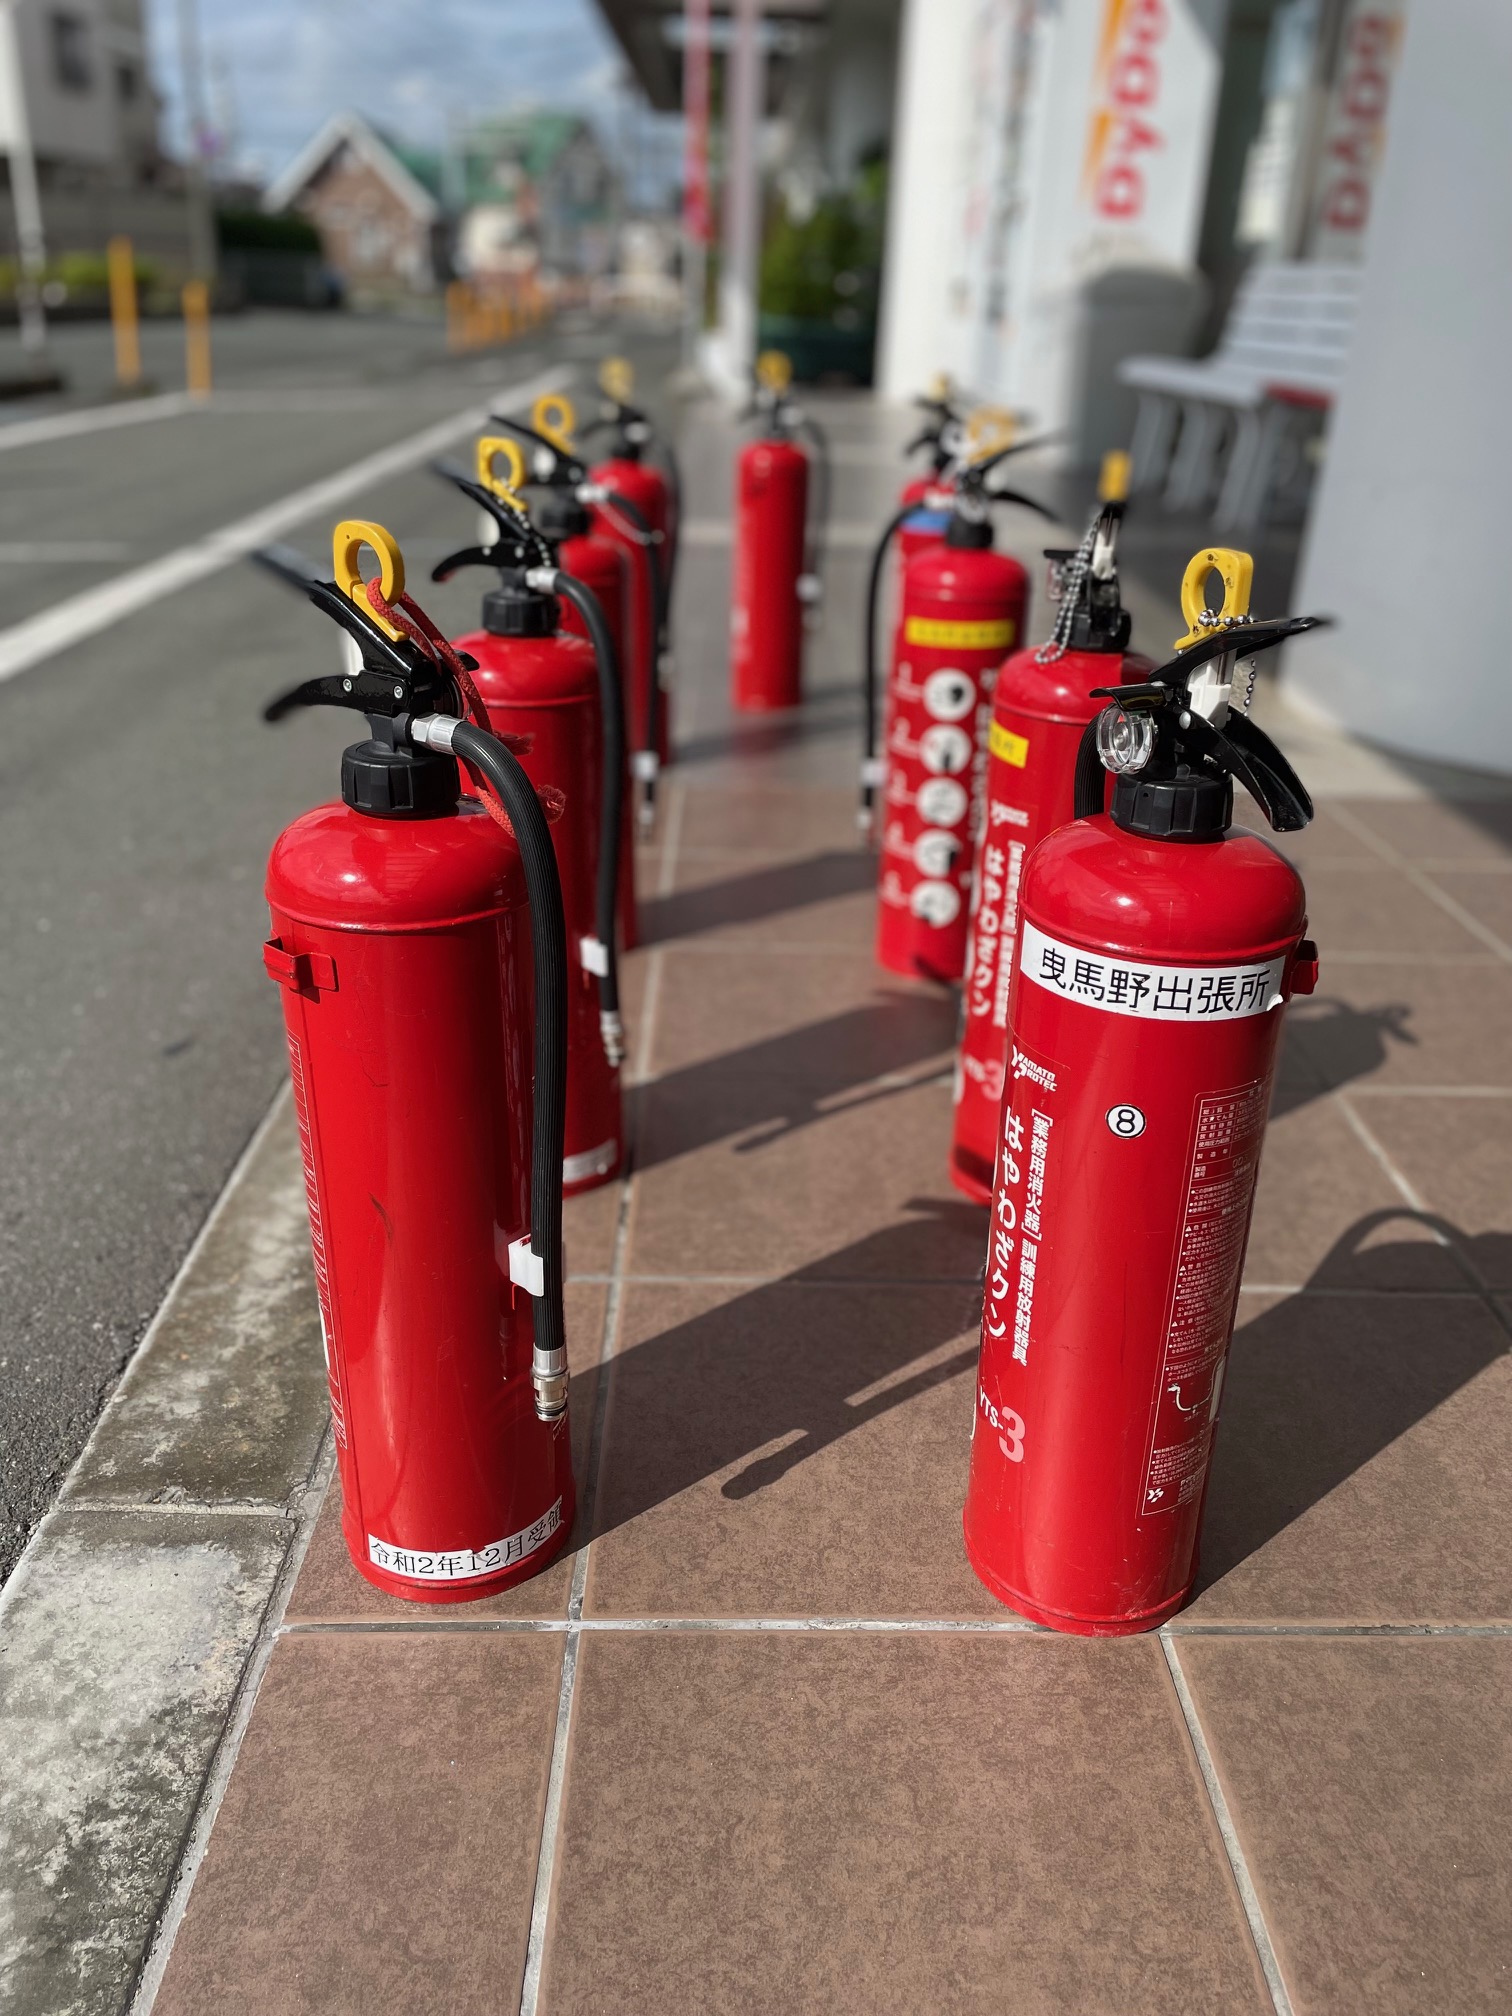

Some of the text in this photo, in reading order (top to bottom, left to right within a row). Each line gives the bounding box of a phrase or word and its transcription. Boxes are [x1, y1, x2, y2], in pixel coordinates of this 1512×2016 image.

[1039, 947, 1271, 1014] 曳馬野出張所
[1011, 1044, 1056, 1081] YAMATO
[988, 1105, 1025, 1338] はやわざクン
[979, 1385, 1026, 1463] YTS-3
